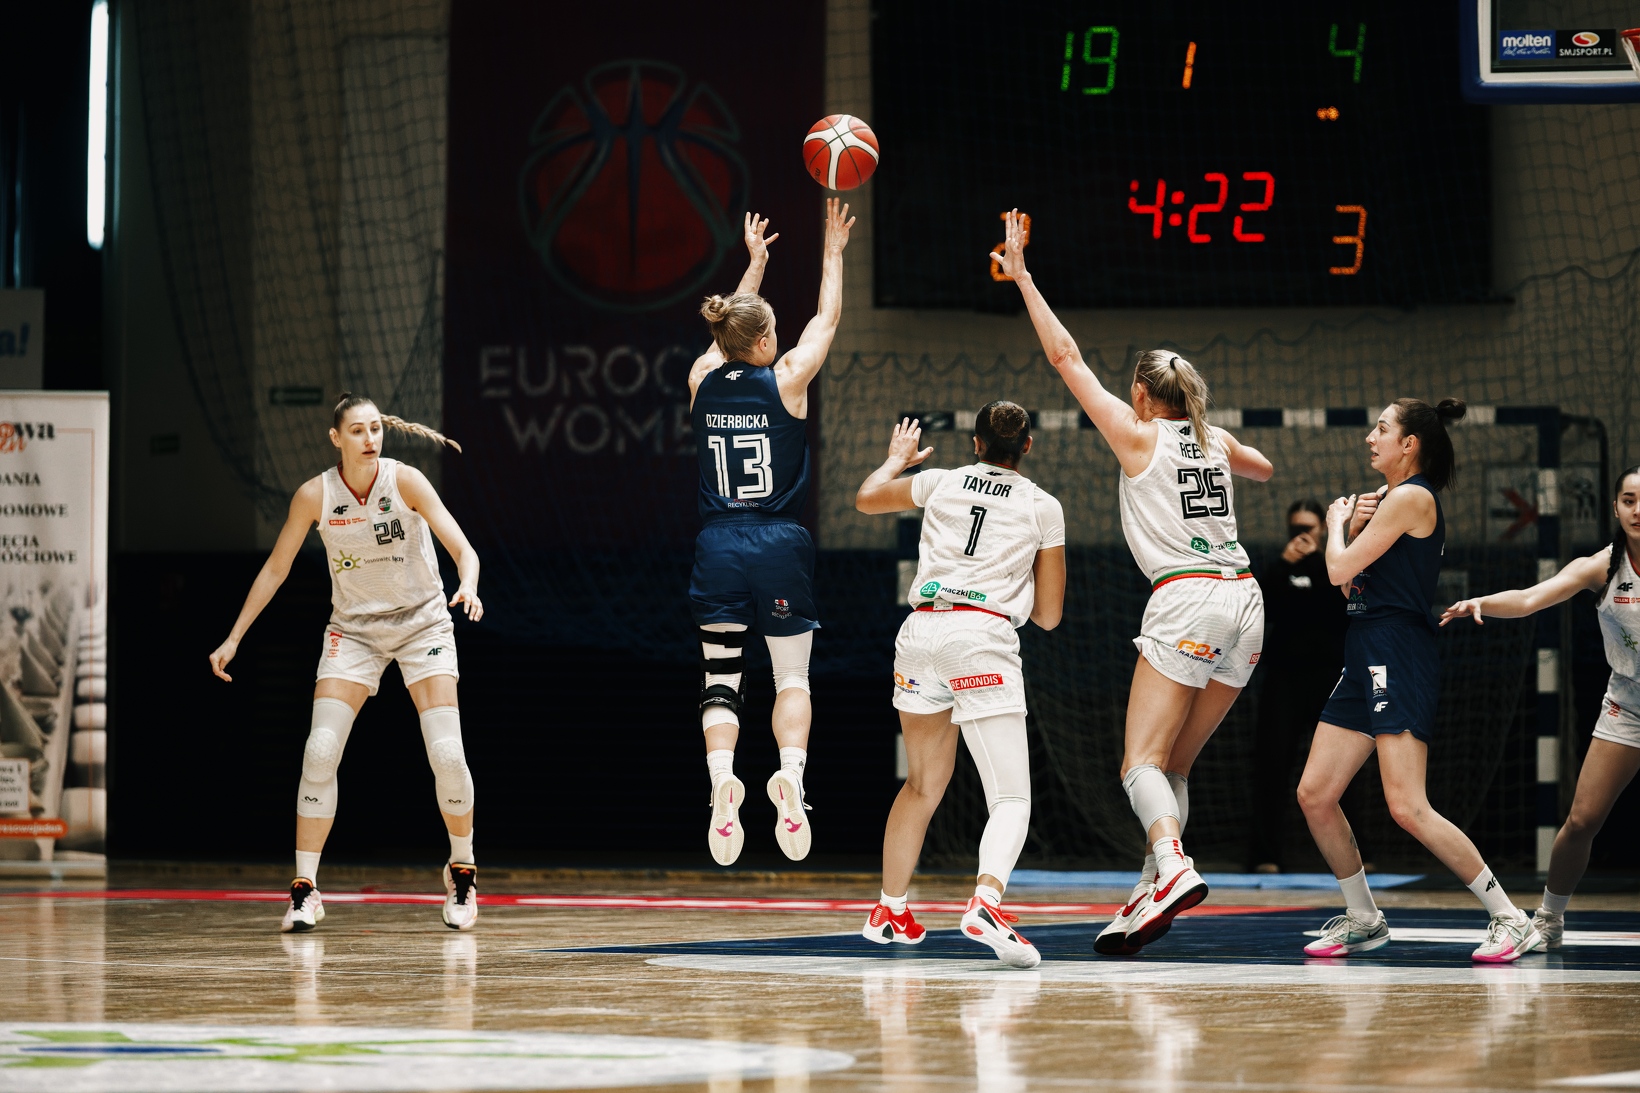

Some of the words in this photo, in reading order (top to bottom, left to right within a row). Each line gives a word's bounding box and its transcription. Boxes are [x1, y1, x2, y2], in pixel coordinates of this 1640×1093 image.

[1329, 23, 1367, 84] 4
[1502, 34, 1552, 48] molten
[1559, 47, 1614, 57] SMJSPORT.PL
[1060, 26, 1119, 95] 19
[1182, 42, 1197, 89] 1
[1128, 172, 1275, 243] 4:22
[1329, 205, 1367, 275] 3
[479, 344, 702, 398] EUROC
[725, 370, 744, 381] 4F
[706, 413, 769, 429] DZIERBICKA
[707, 433, 773, 499] 13
[962, 474, 1013, 498] TAYLOR
[1177, 467, 1230, 519] 25
[333, 505, 349, 514] 4F
[0, 534, 39, 551] ĘCIA
[374, 518, 405, 545] 24
[963, 505, 988, 557] 1
[1617, 582, 1633, 592] 4F
[427, 647, 442, 656] 4F
[1374, 701, 1388, 713] 4F
